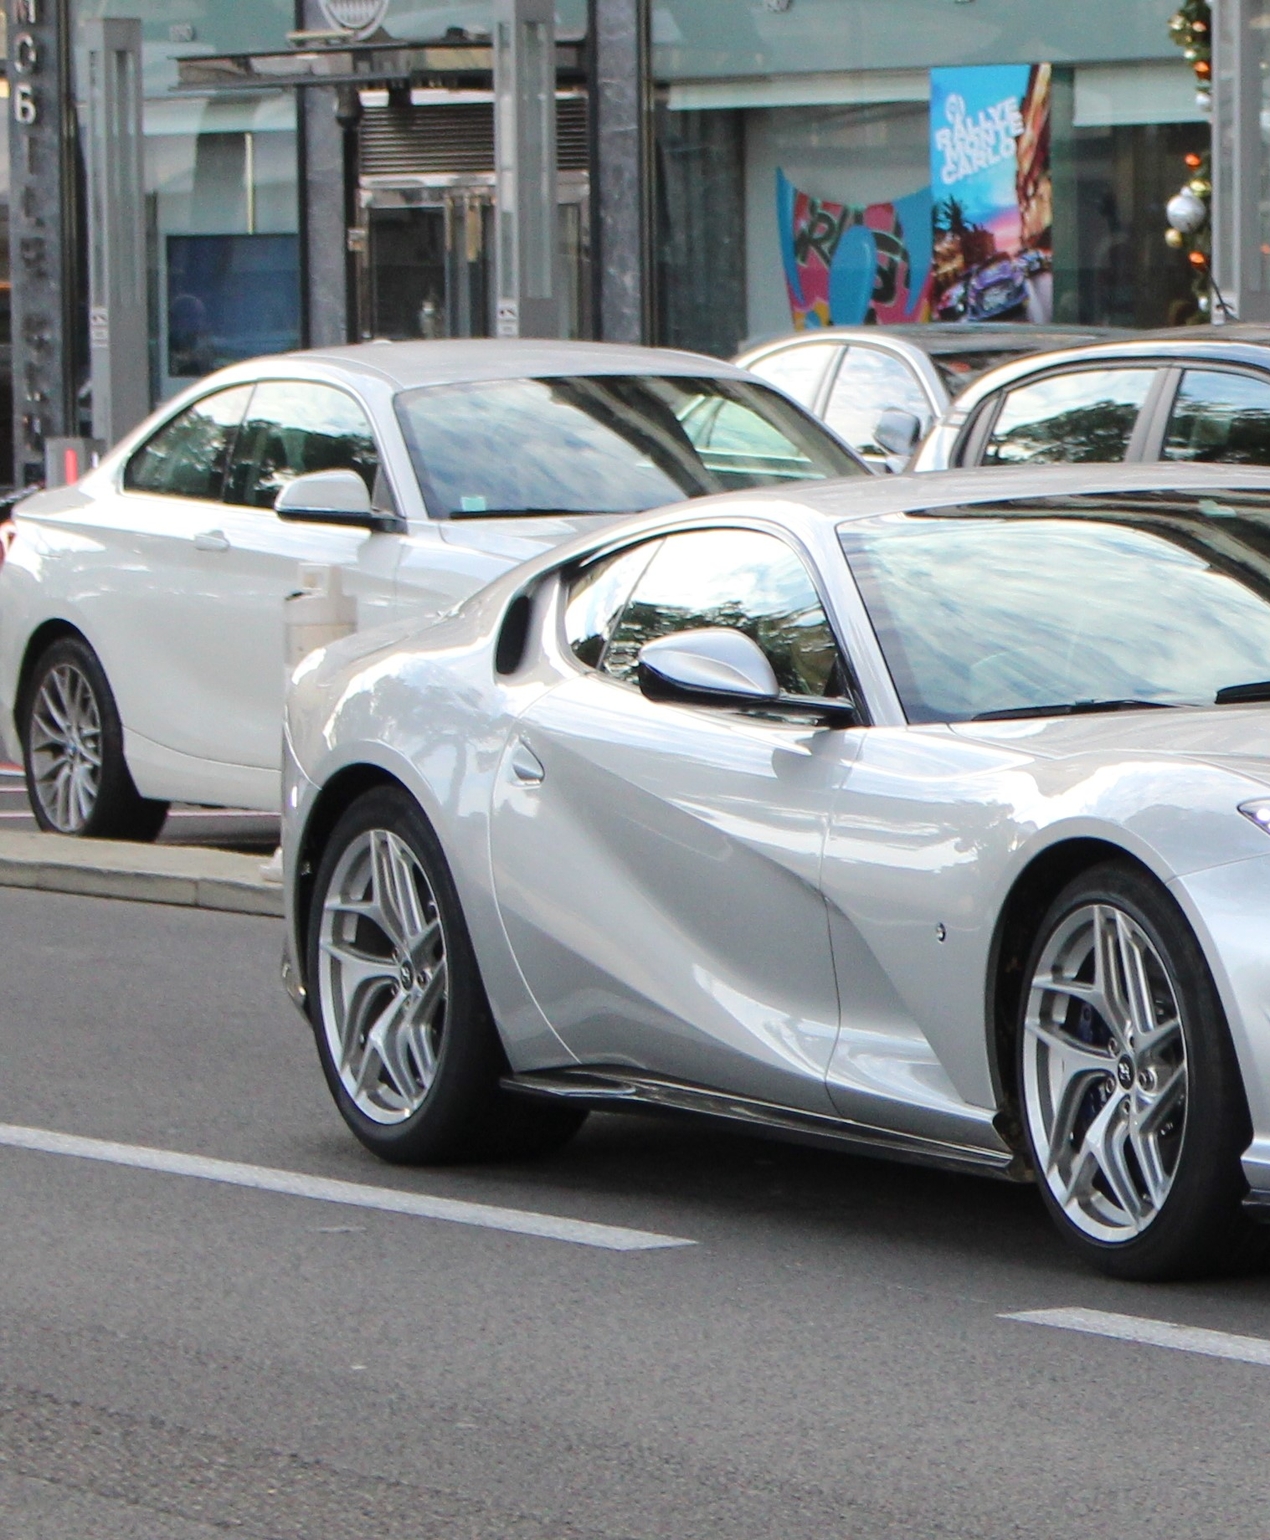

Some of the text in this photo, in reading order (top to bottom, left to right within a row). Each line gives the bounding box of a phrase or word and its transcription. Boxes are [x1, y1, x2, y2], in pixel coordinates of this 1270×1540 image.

[936, 96, 1020, 151] RALLYE
[944, 112, 1025, 168] MONTE
[942, 136, 1018, 184] CARLO
